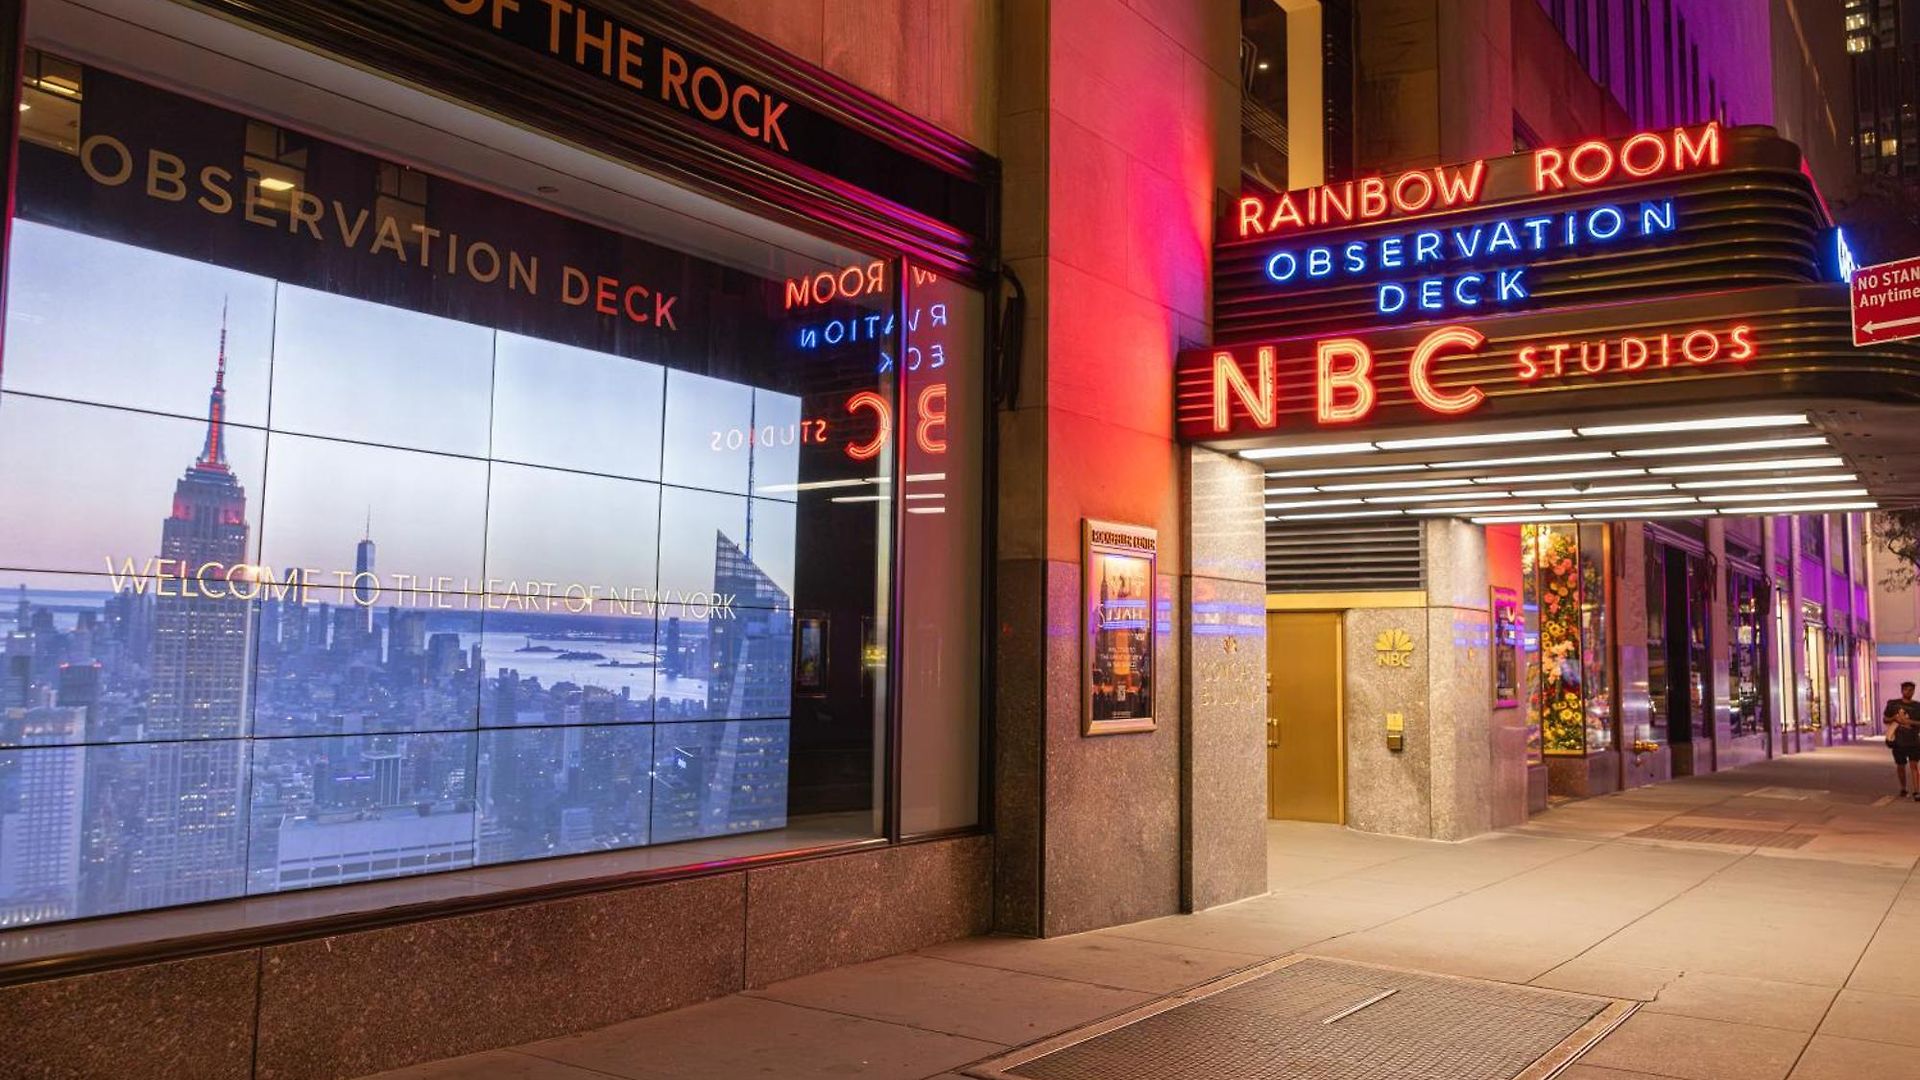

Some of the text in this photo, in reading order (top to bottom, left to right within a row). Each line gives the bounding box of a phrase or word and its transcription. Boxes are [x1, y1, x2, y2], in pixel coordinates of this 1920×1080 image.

[540, 0, 644, 89] THE
[661, 47, 790, 151] ROCK
[79, 134, 678, 331] OBSERVATION DECK
[1239, 121, 1722, 236] RAINBOW ROOM
[1266, 200, 1676, 314] OBSERVATION DECK
[1858, 275, 1878, 291] NO
[1859, 286, 1920, 308] Anytime
[1211, 324, 1756, 434] NBC STUDIOS
[105, 556, 736, 619] WELCOME TO THE HEART OF NEW YORK
[1377, 652, 1411, 668] NBC
